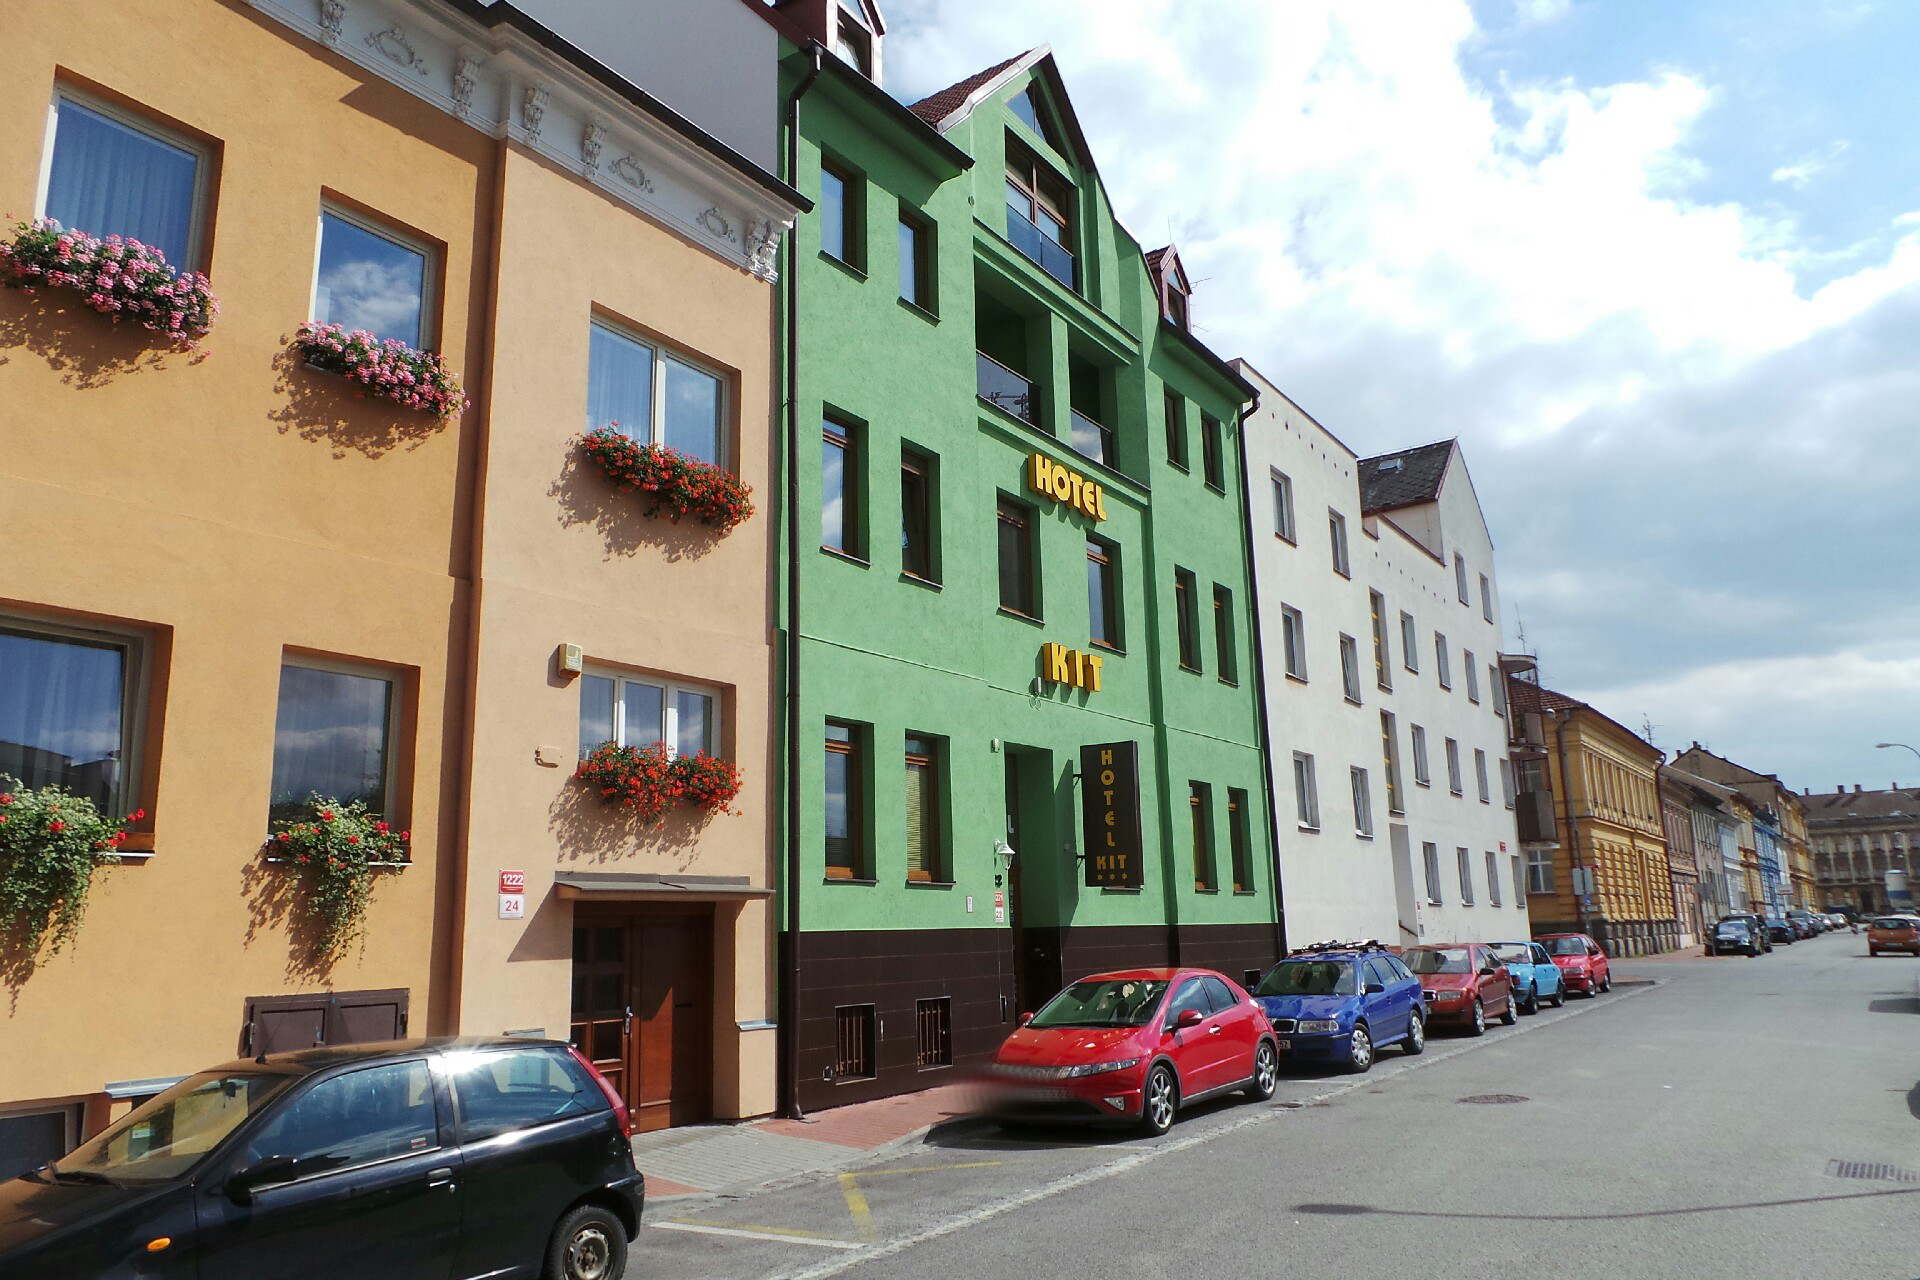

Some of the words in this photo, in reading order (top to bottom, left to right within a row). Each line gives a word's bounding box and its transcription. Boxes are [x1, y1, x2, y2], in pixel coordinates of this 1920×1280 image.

[1029, 453, 1107, 522] HOTEL
[1043, 642, 1103, 692] KIT
[1100, 749, 1116, 847] HOTEL
[1096, 854, 1127, 870] KIT
[502, 874, 524, 885] 1222
[505, 900, 519, 911] 24
[995, 910, 1003, 918] 22
